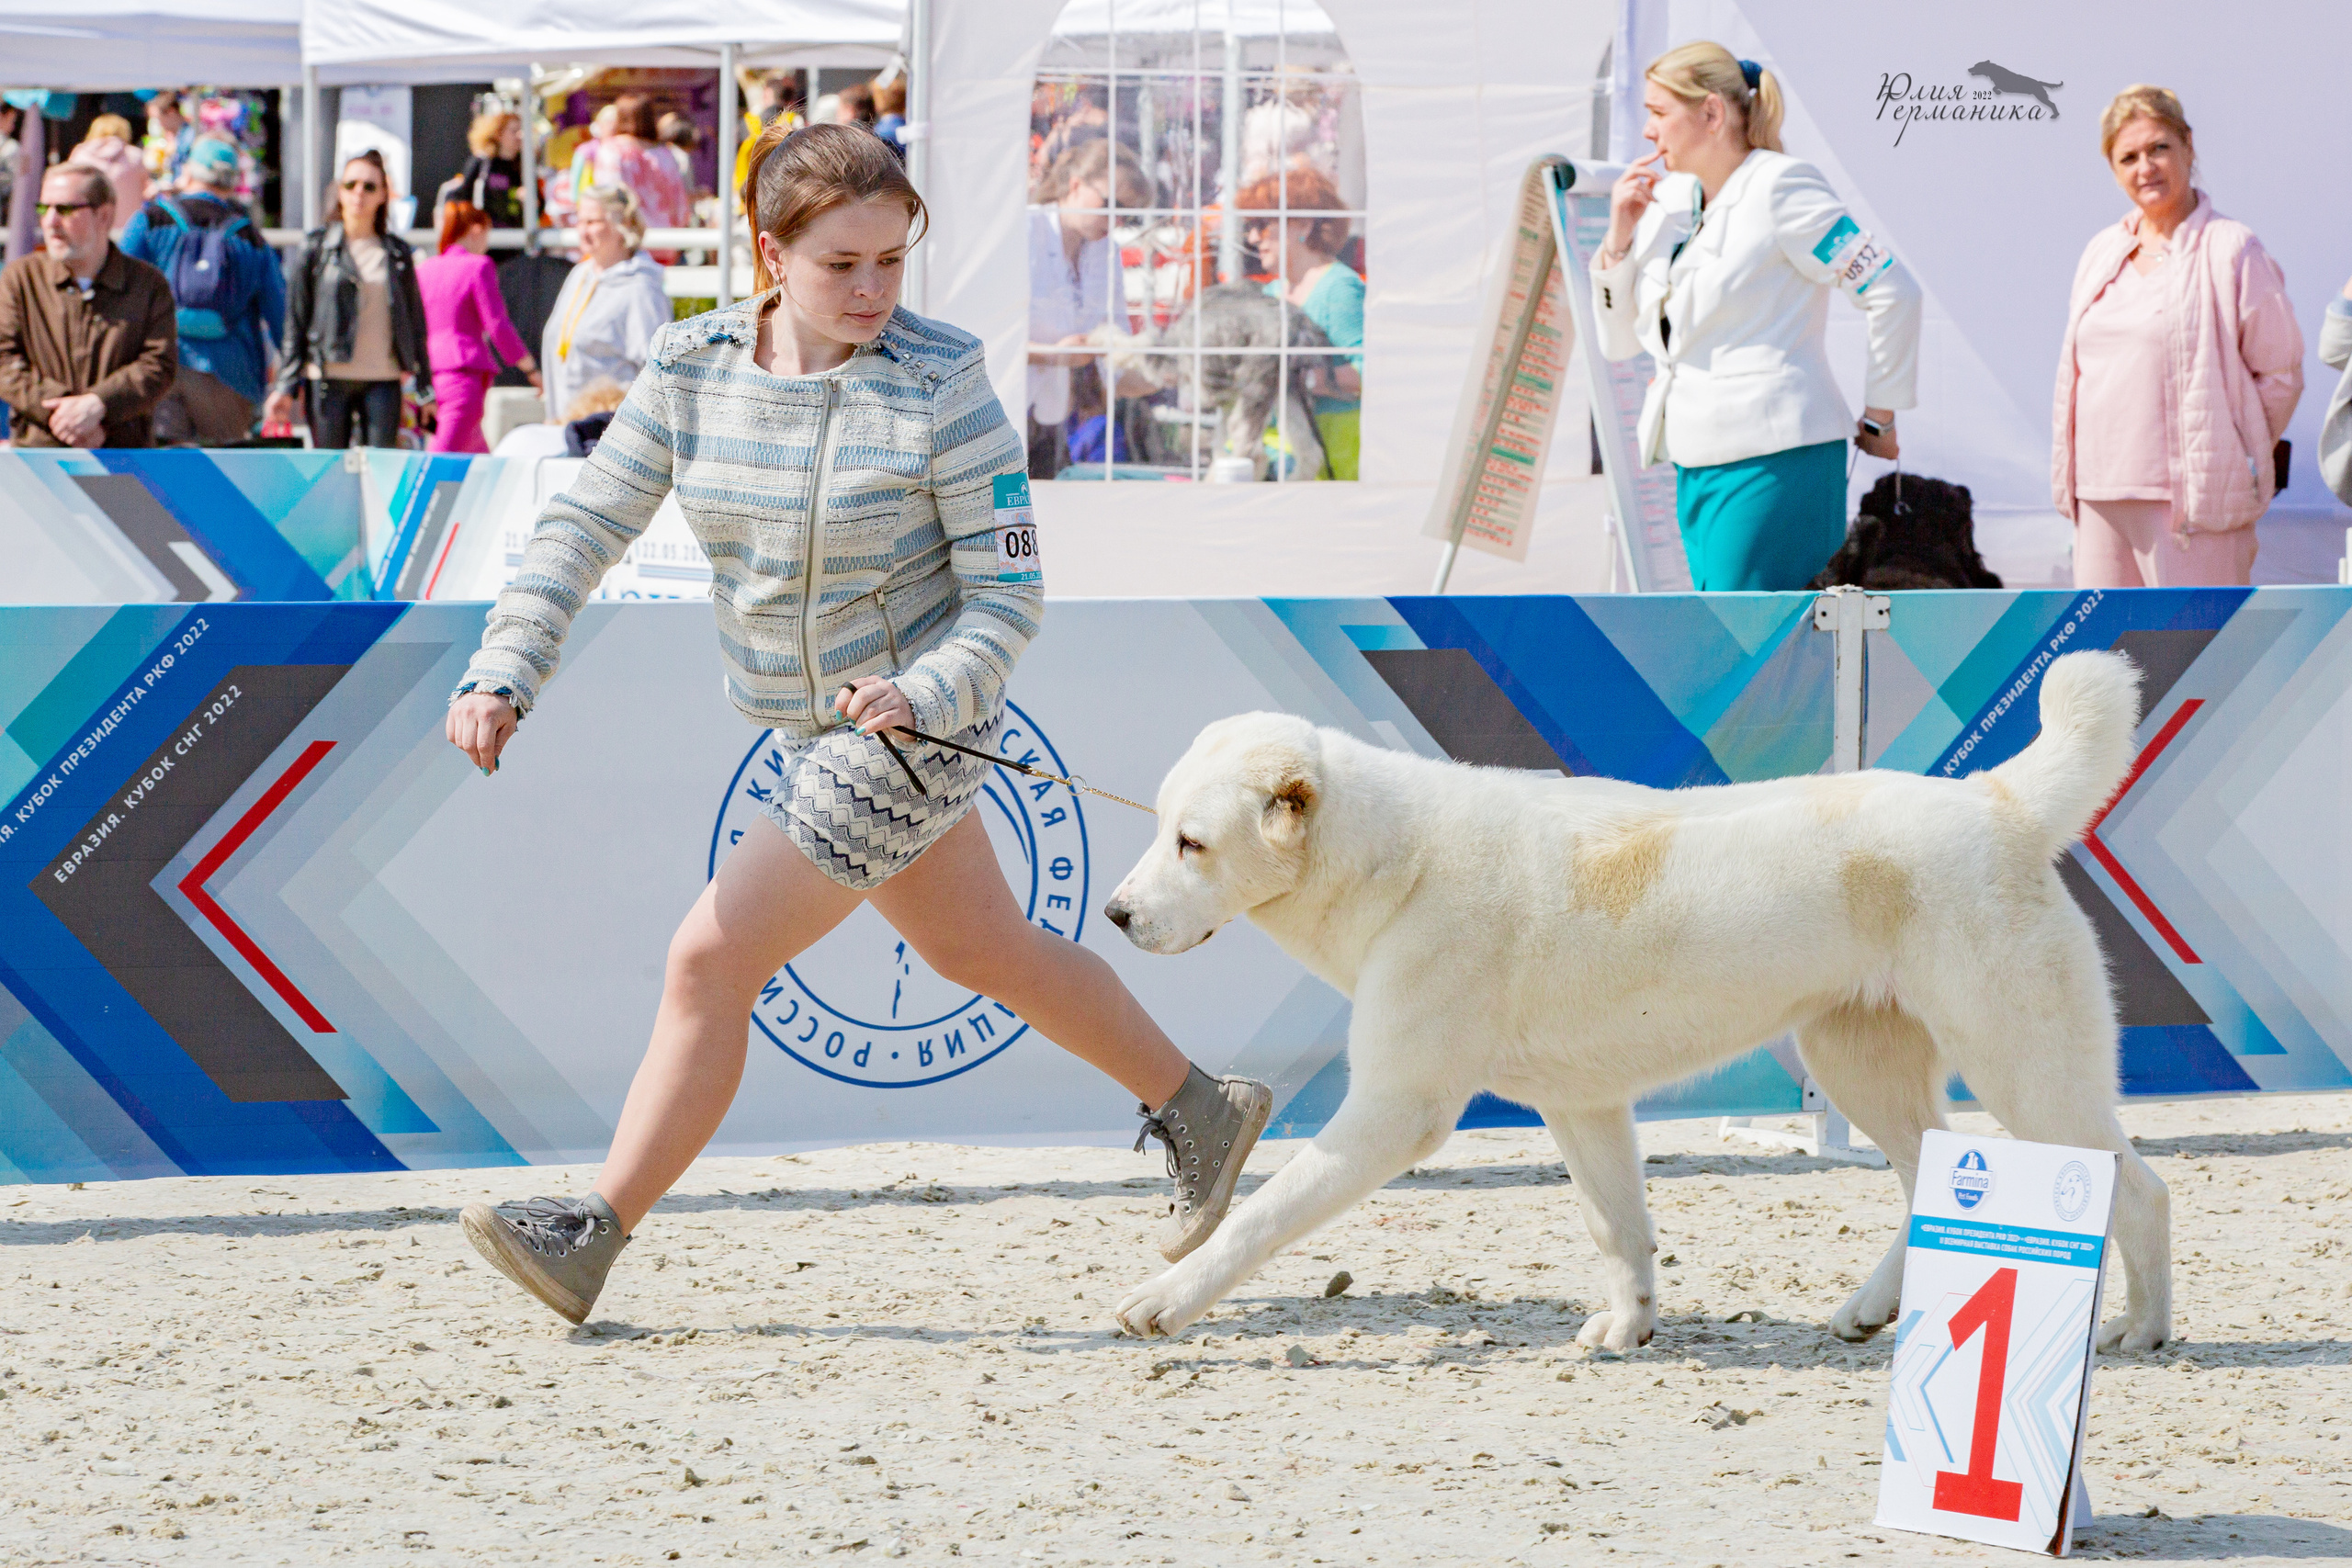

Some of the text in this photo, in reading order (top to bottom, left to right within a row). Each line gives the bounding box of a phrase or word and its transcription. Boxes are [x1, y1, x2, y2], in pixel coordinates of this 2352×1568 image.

[16, 773, 63, 823] КУБОК
[59, 685, 148, 775] ПРЕЗИДЕНТА
[143, 654, 175, 686] РКФ
[174, 618, 209, 655] 2022
[1943, 589, 2105, 776] КУБОК ПРЕЗИДЕНТА РКФ 2022
[53, 684, 242, 884] ЕВРАЗИЯ. КУБОК СНГ 2022
[1951, 1170, 1989, 1189] Farmina
[1932, 1267, 2024, 1523] 1
